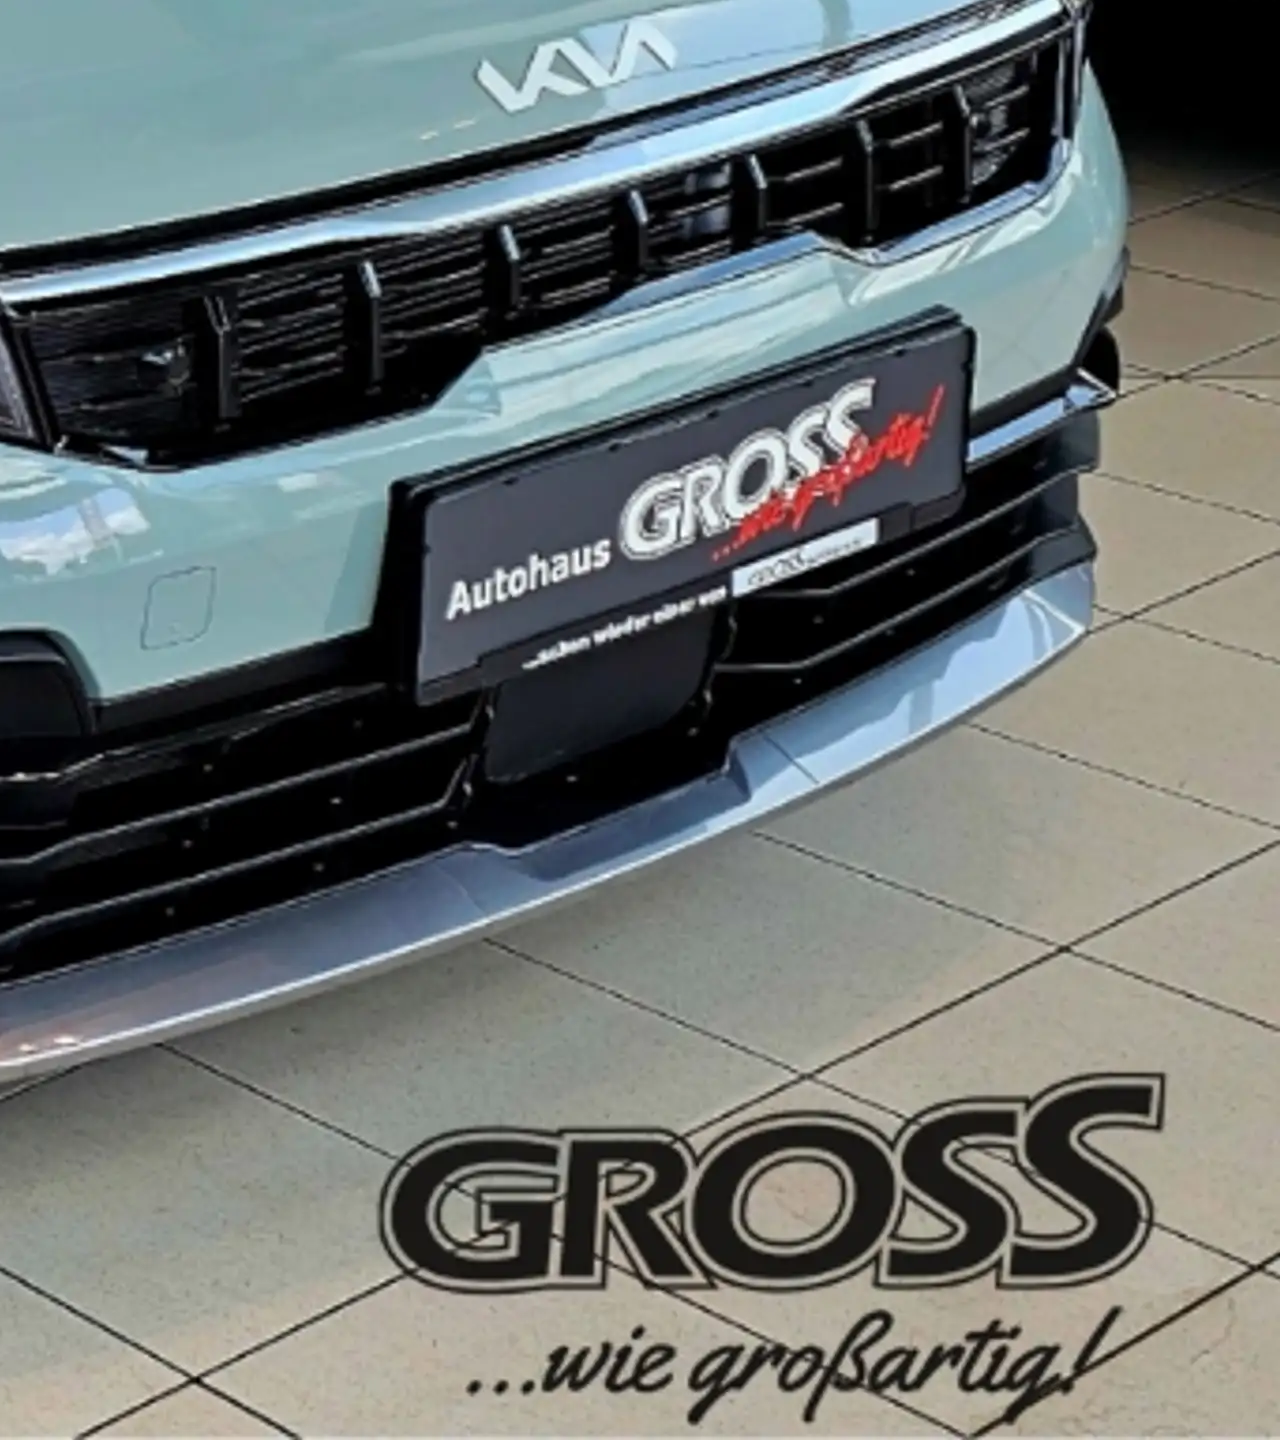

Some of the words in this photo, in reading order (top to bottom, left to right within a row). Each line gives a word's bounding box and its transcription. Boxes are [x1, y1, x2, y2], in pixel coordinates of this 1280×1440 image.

[475, 17, 678, 115] KIA
[445, 538, 612, 621] Autohaus
[619, 377, 876, 563] GROSS
